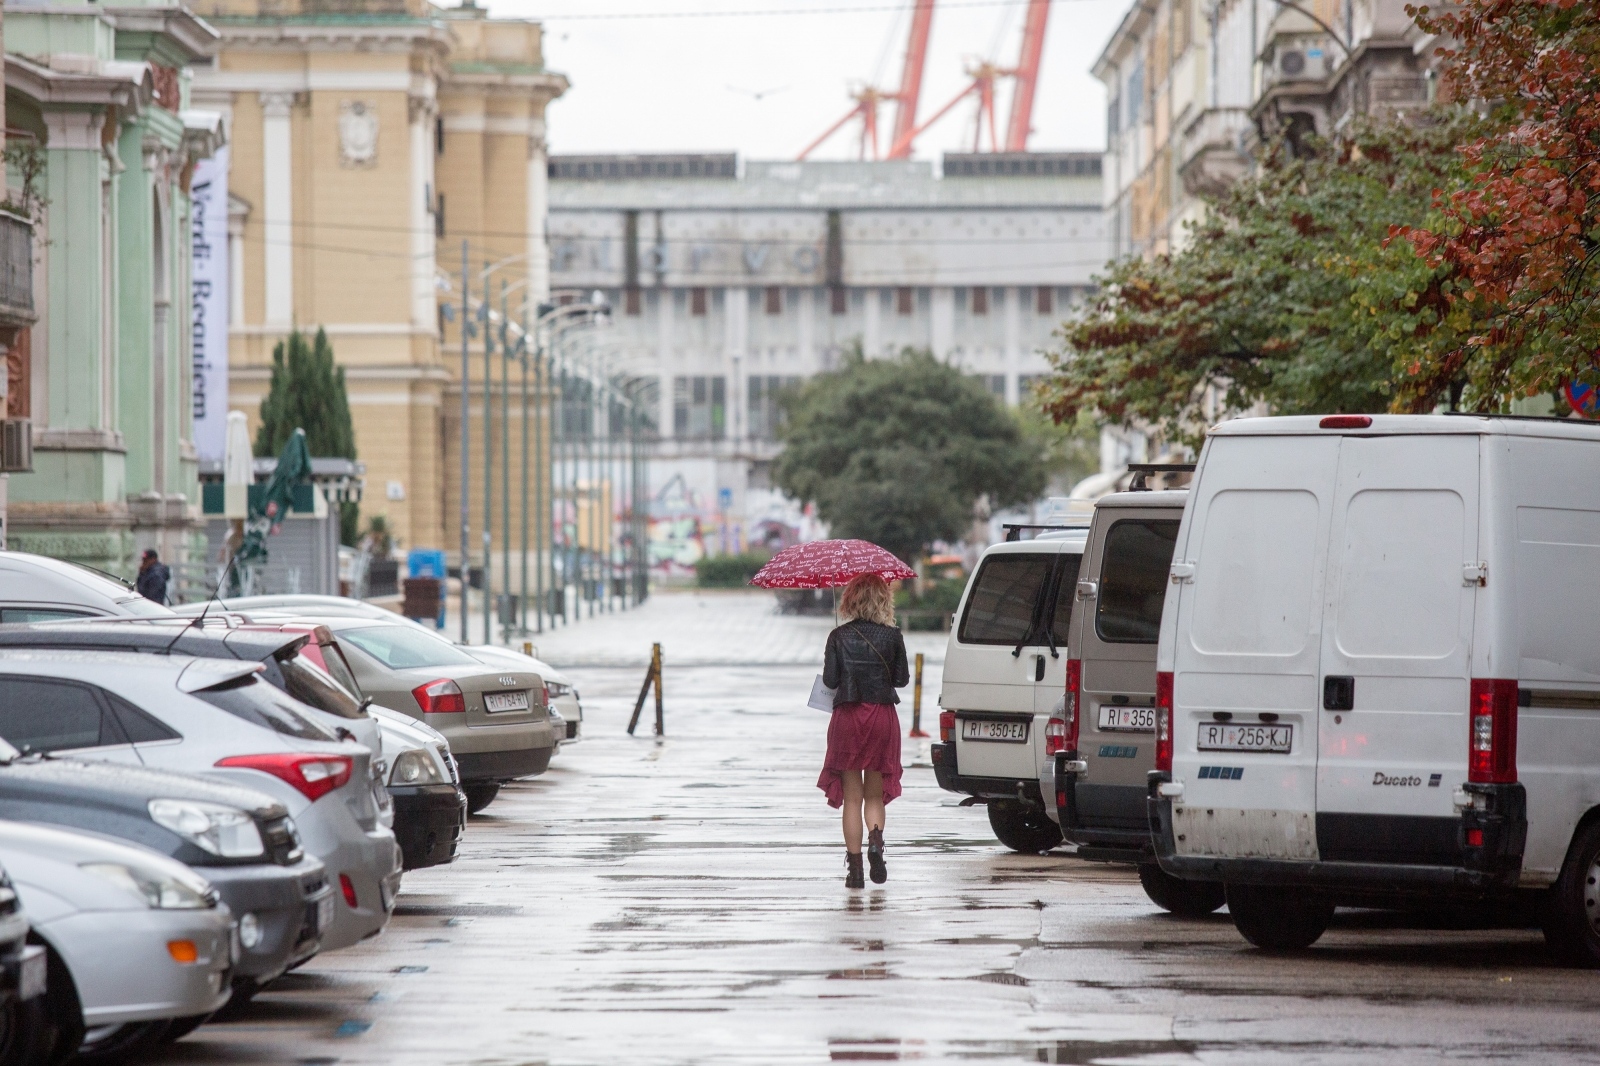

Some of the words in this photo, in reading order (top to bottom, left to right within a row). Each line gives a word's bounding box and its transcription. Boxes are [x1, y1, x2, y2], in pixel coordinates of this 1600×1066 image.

[1108, 709, 1120, 726] RI
[1130, 709, 1154, 727] 356
[970, 722, 981, 736] RI
[989, 723, 1024, 738] 350-EA
[1208, 727, 1224, 745] RI
[1237, 728, 1289, 747] 256-KJ
[1372, 771, 1421, 786] Ducato
